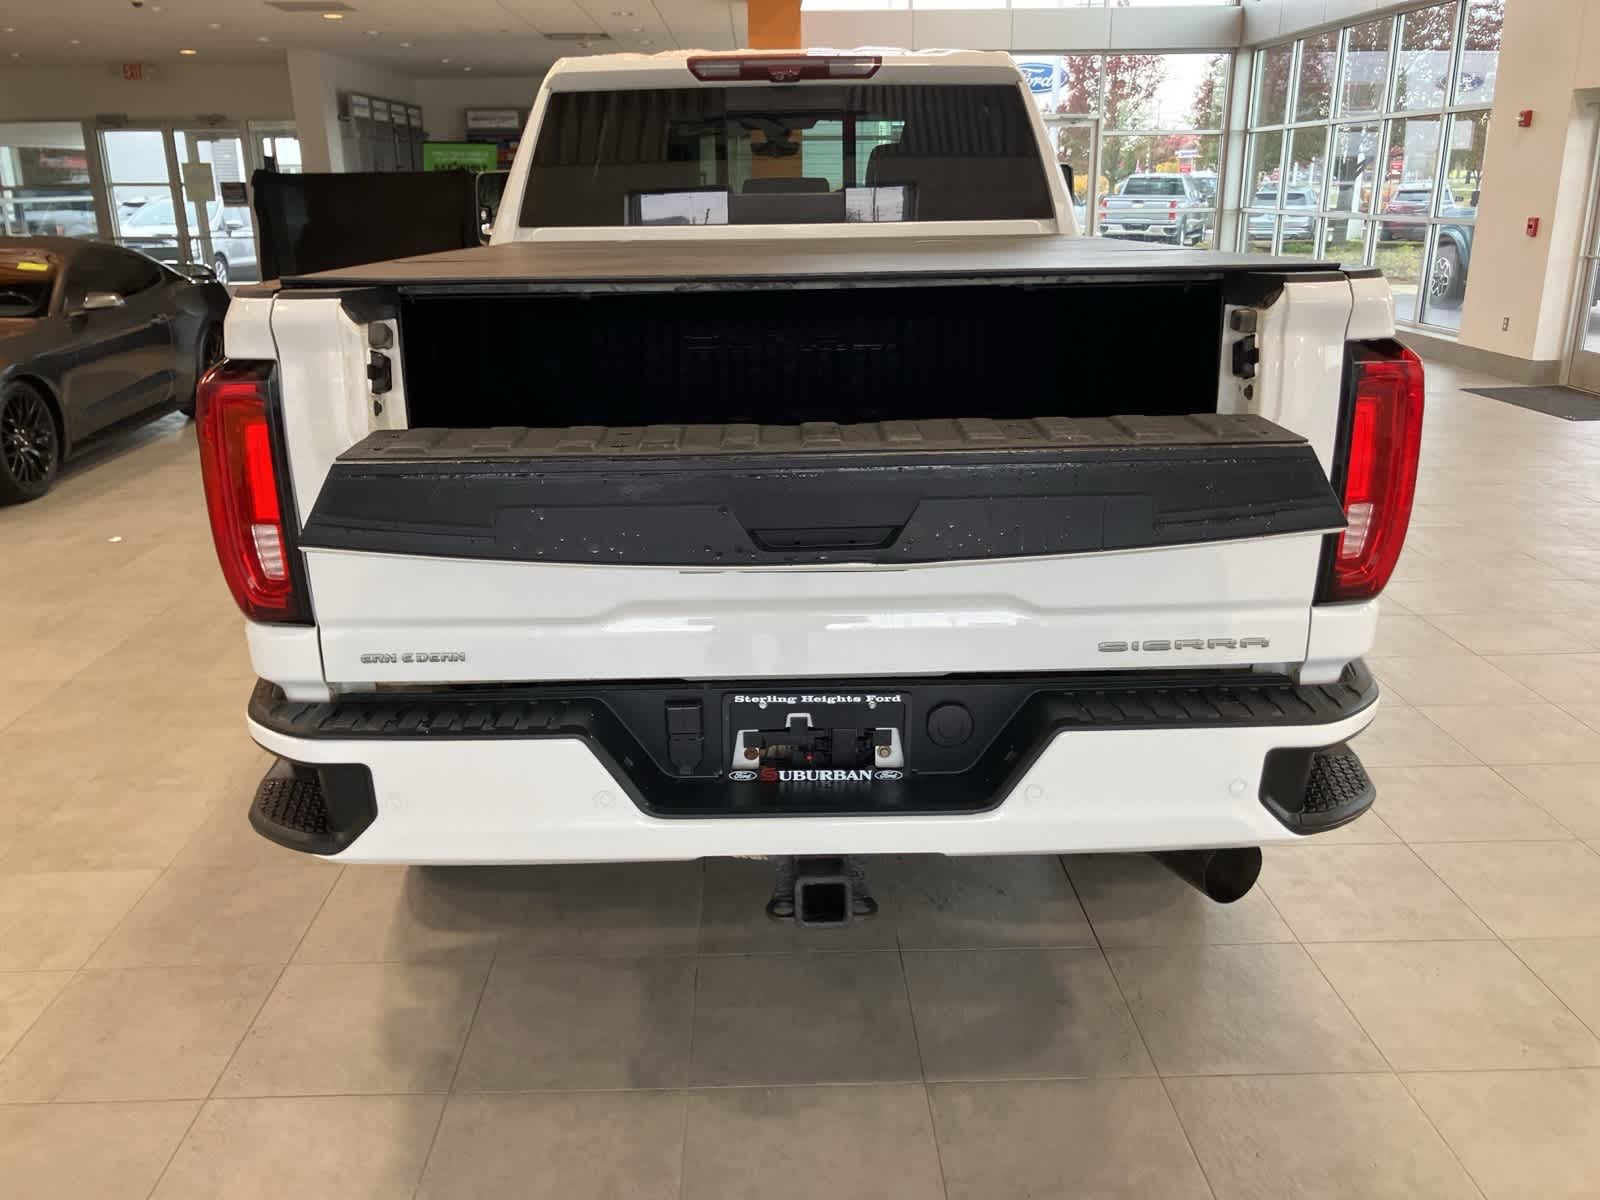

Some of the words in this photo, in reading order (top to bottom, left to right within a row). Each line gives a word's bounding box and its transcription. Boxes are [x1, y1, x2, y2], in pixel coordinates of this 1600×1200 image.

[1097, 637, 1270, 652] SIERRA
[734, 695, 797, 704] Sterling
[801, 695, 861, 704] Heights
[865, 694, 901, 703] Ford
[760, 768, 872, 781] SUBURBAN
